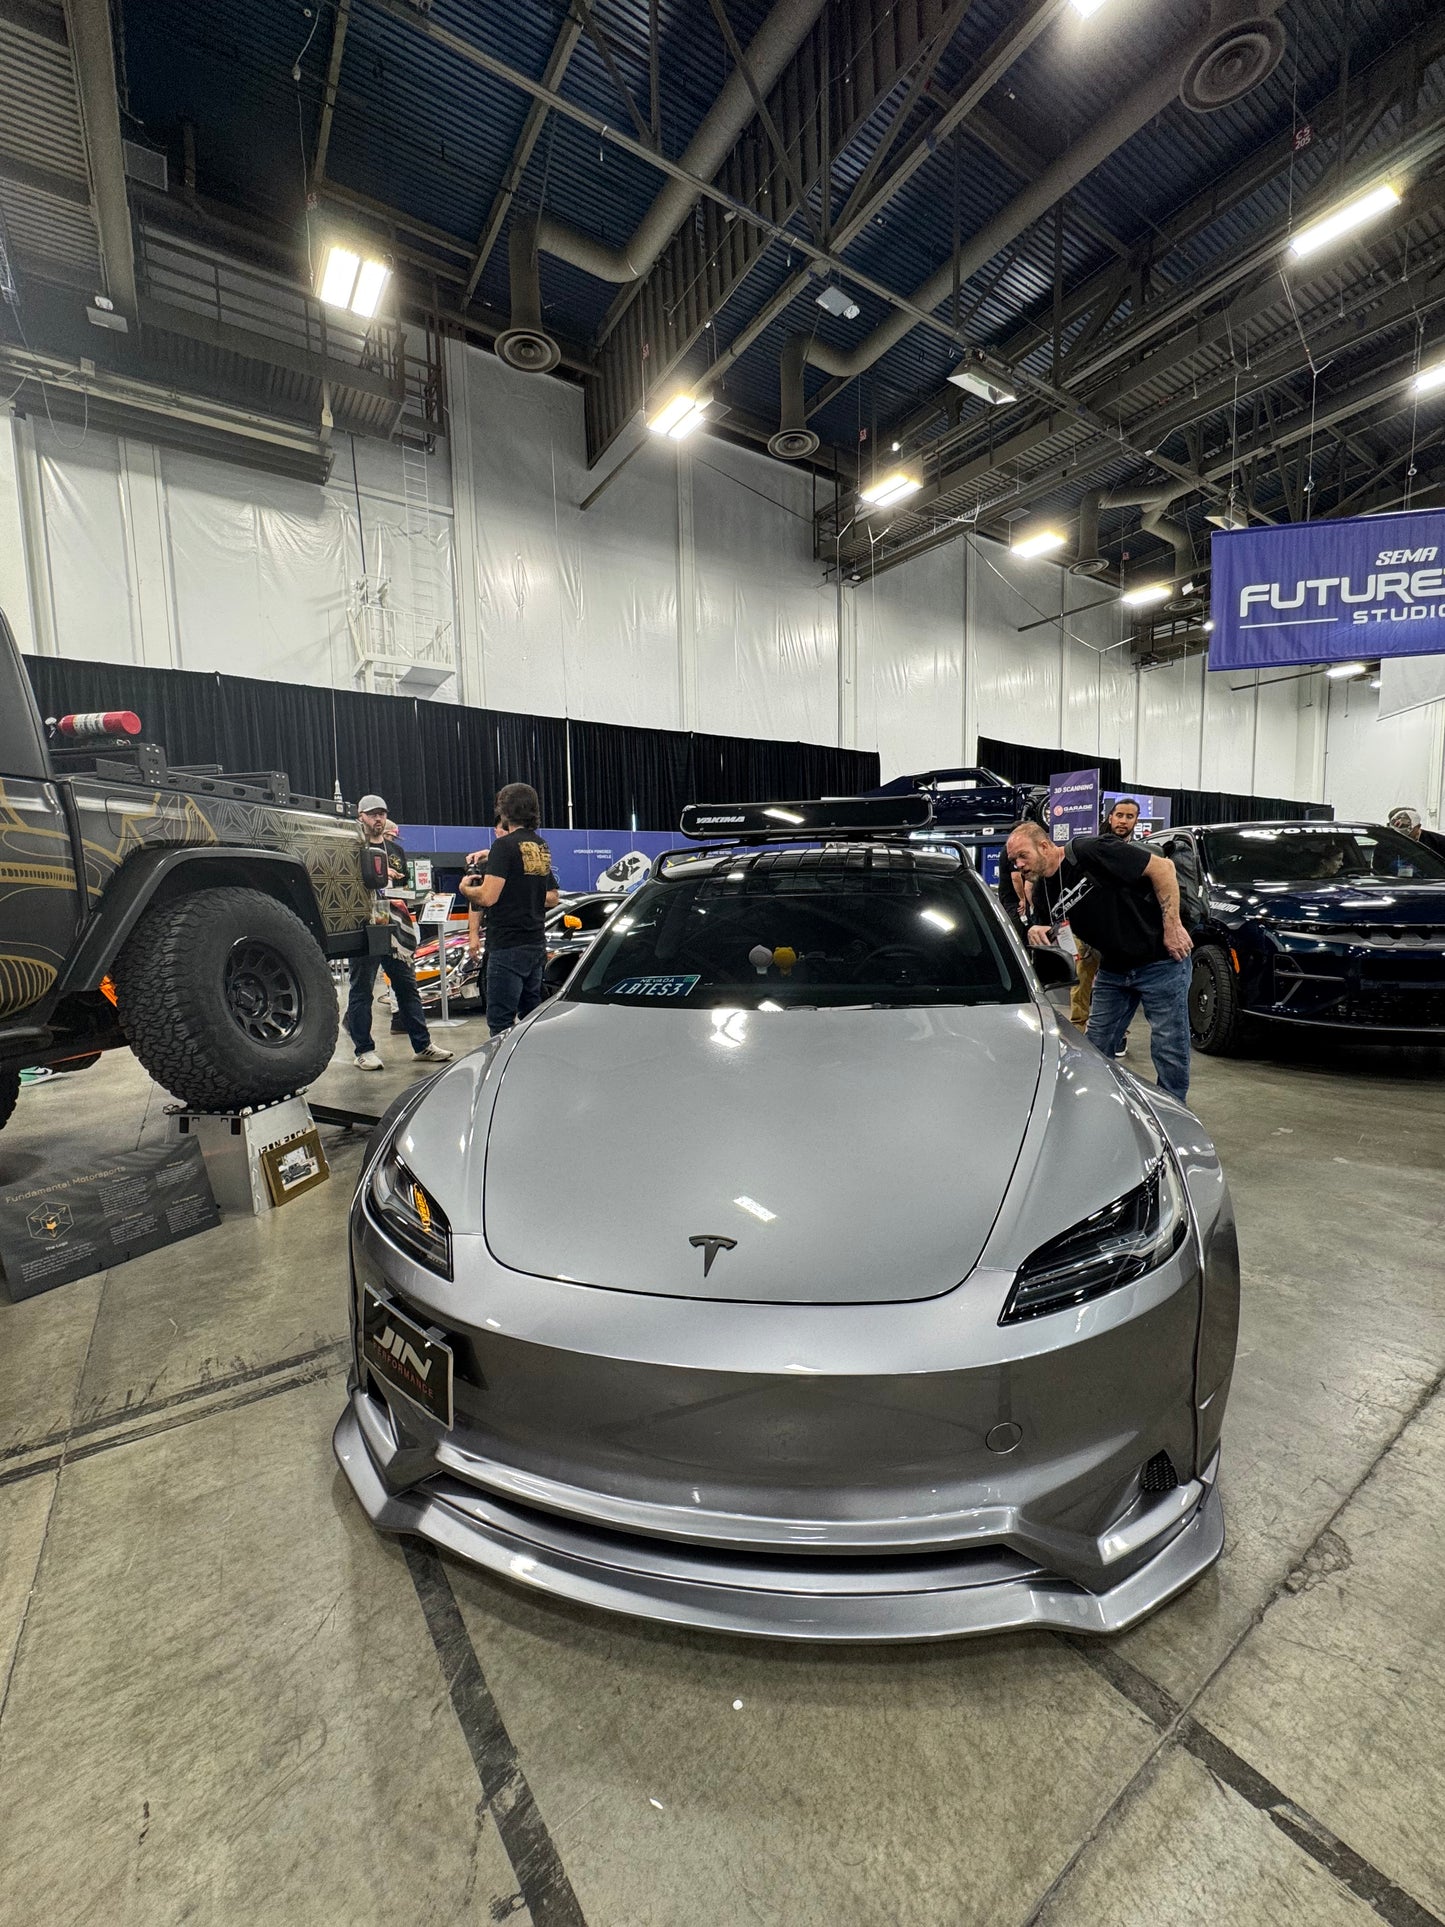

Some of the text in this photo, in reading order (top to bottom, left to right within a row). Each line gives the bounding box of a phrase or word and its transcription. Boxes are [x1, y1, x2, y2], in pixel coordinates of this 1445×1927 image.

[1375, 546, 1438, 566] SEMA
[1240, 568, 1445, 618] FUTURE
[1062, 783, 1094, 793] SCANNING
[696, 816, 746, 824] YAKIMA
[1301, 827, 1368, 835] TIRES
[615, 983, 684, 996] LBTES3
[5, 1166, 127, 1204] Fundamental Motorsports
[373, 1326, 433, 1381] JIN
[373, 1341, 434, 1399] PERFORMANCE
